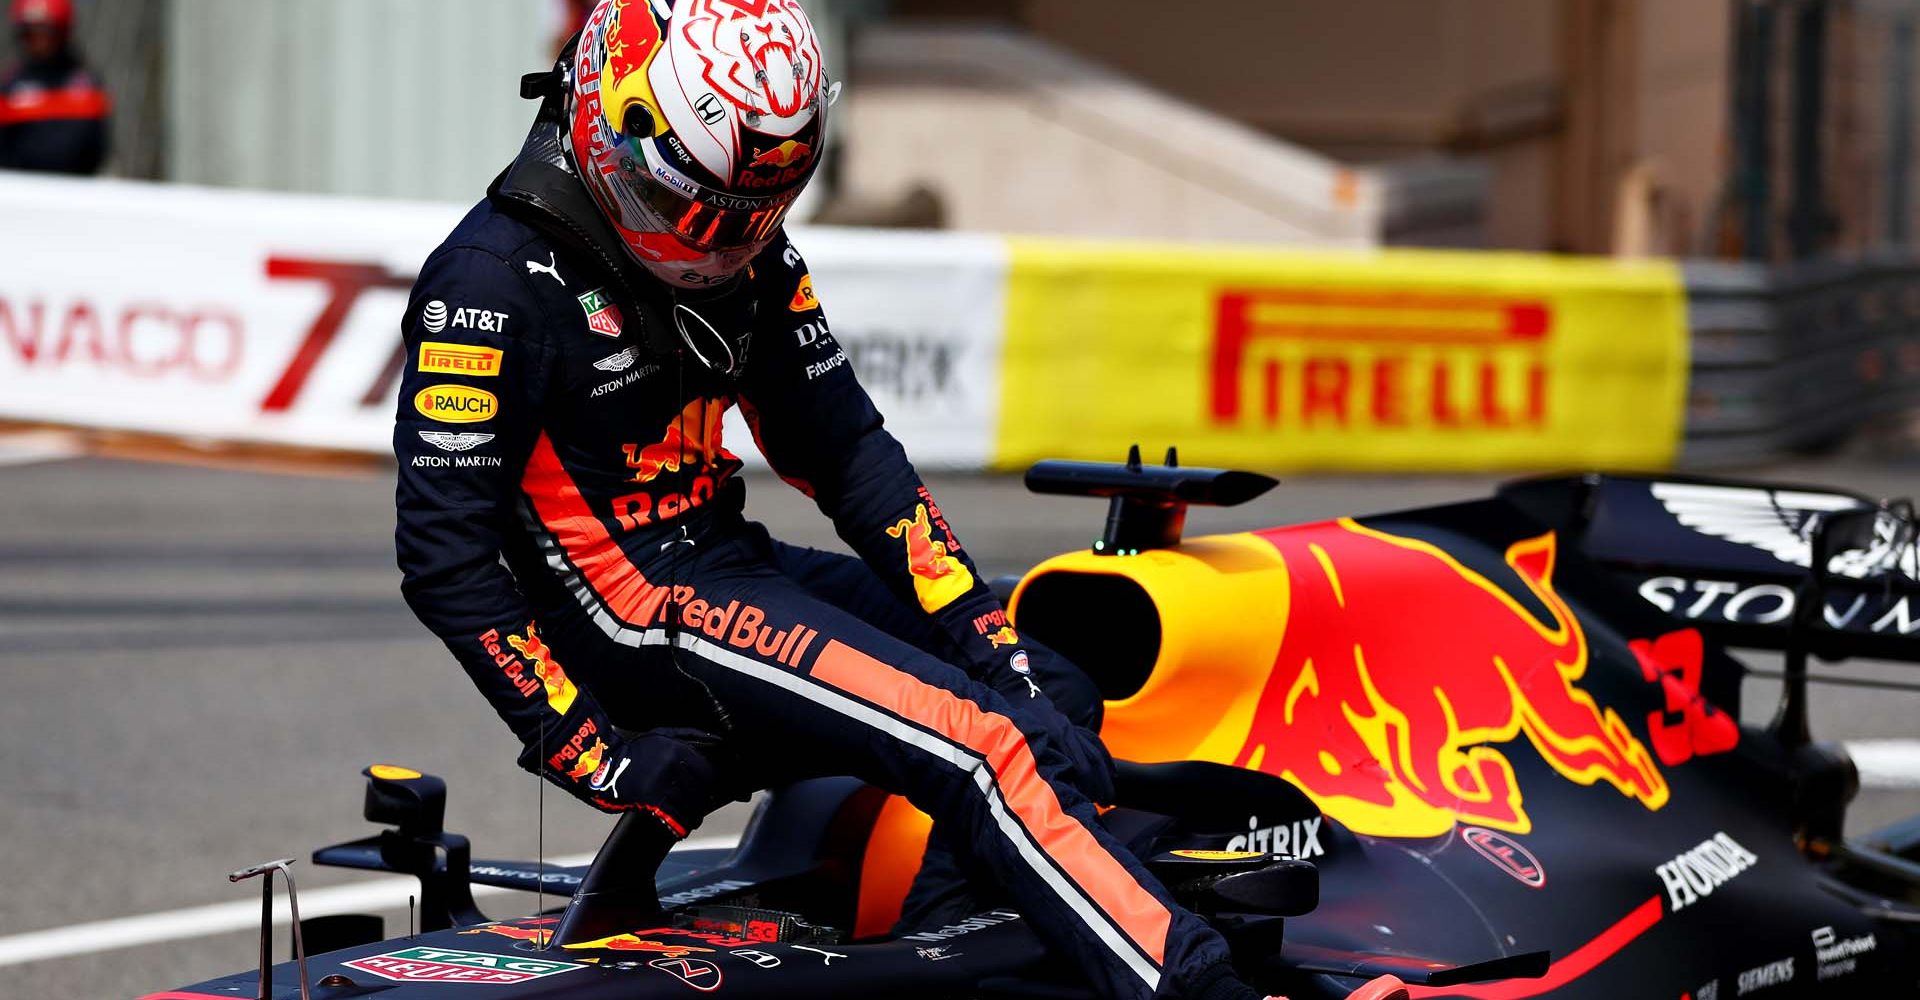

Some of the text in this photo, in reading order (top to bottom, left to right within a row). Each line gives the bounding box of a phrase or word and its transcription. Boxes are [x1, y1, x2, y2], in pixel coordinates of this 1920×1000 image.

[452, 307, 509, 333] AT&T
[0, 296, 244, 382] NACO
[423, 349, 495, 371] PIRELLI
[1209, 288, 1552, 430] PIRELLI
[590, 377, 623, 398] ASTON
[435, 396, 491, 413] RAUCH
[412, 455, 502, 468] ASTON MARTIN
[1655, 831, 1758, 912] HONDA
[362, 957, 526, 982] HEUER
[417, 950, 552, 972] TAG
[1737, 956, 1795, 996] SIEMENS
